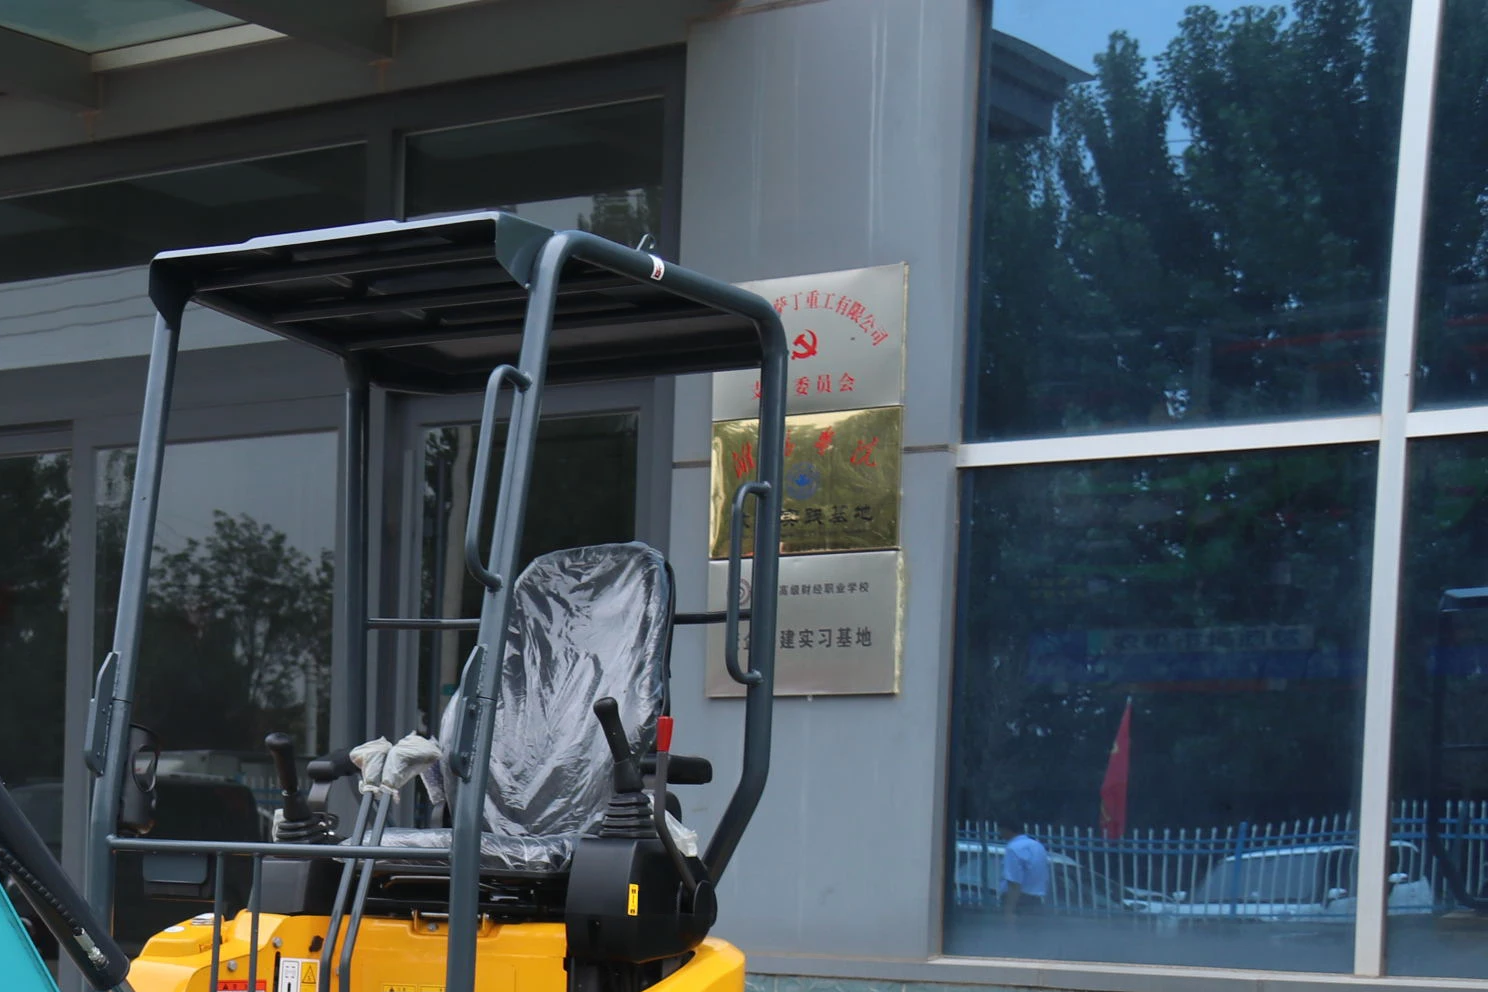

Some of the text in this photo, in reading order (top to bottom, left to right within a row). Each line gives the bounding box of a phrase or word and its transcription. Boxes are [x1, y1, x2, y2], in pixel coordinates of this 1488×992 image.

[743, 504, 873, 528] 实践基地
[779, 582, 869, 596] 高级财经职业学校
[742, 627, 872, 650] 建实习基地
